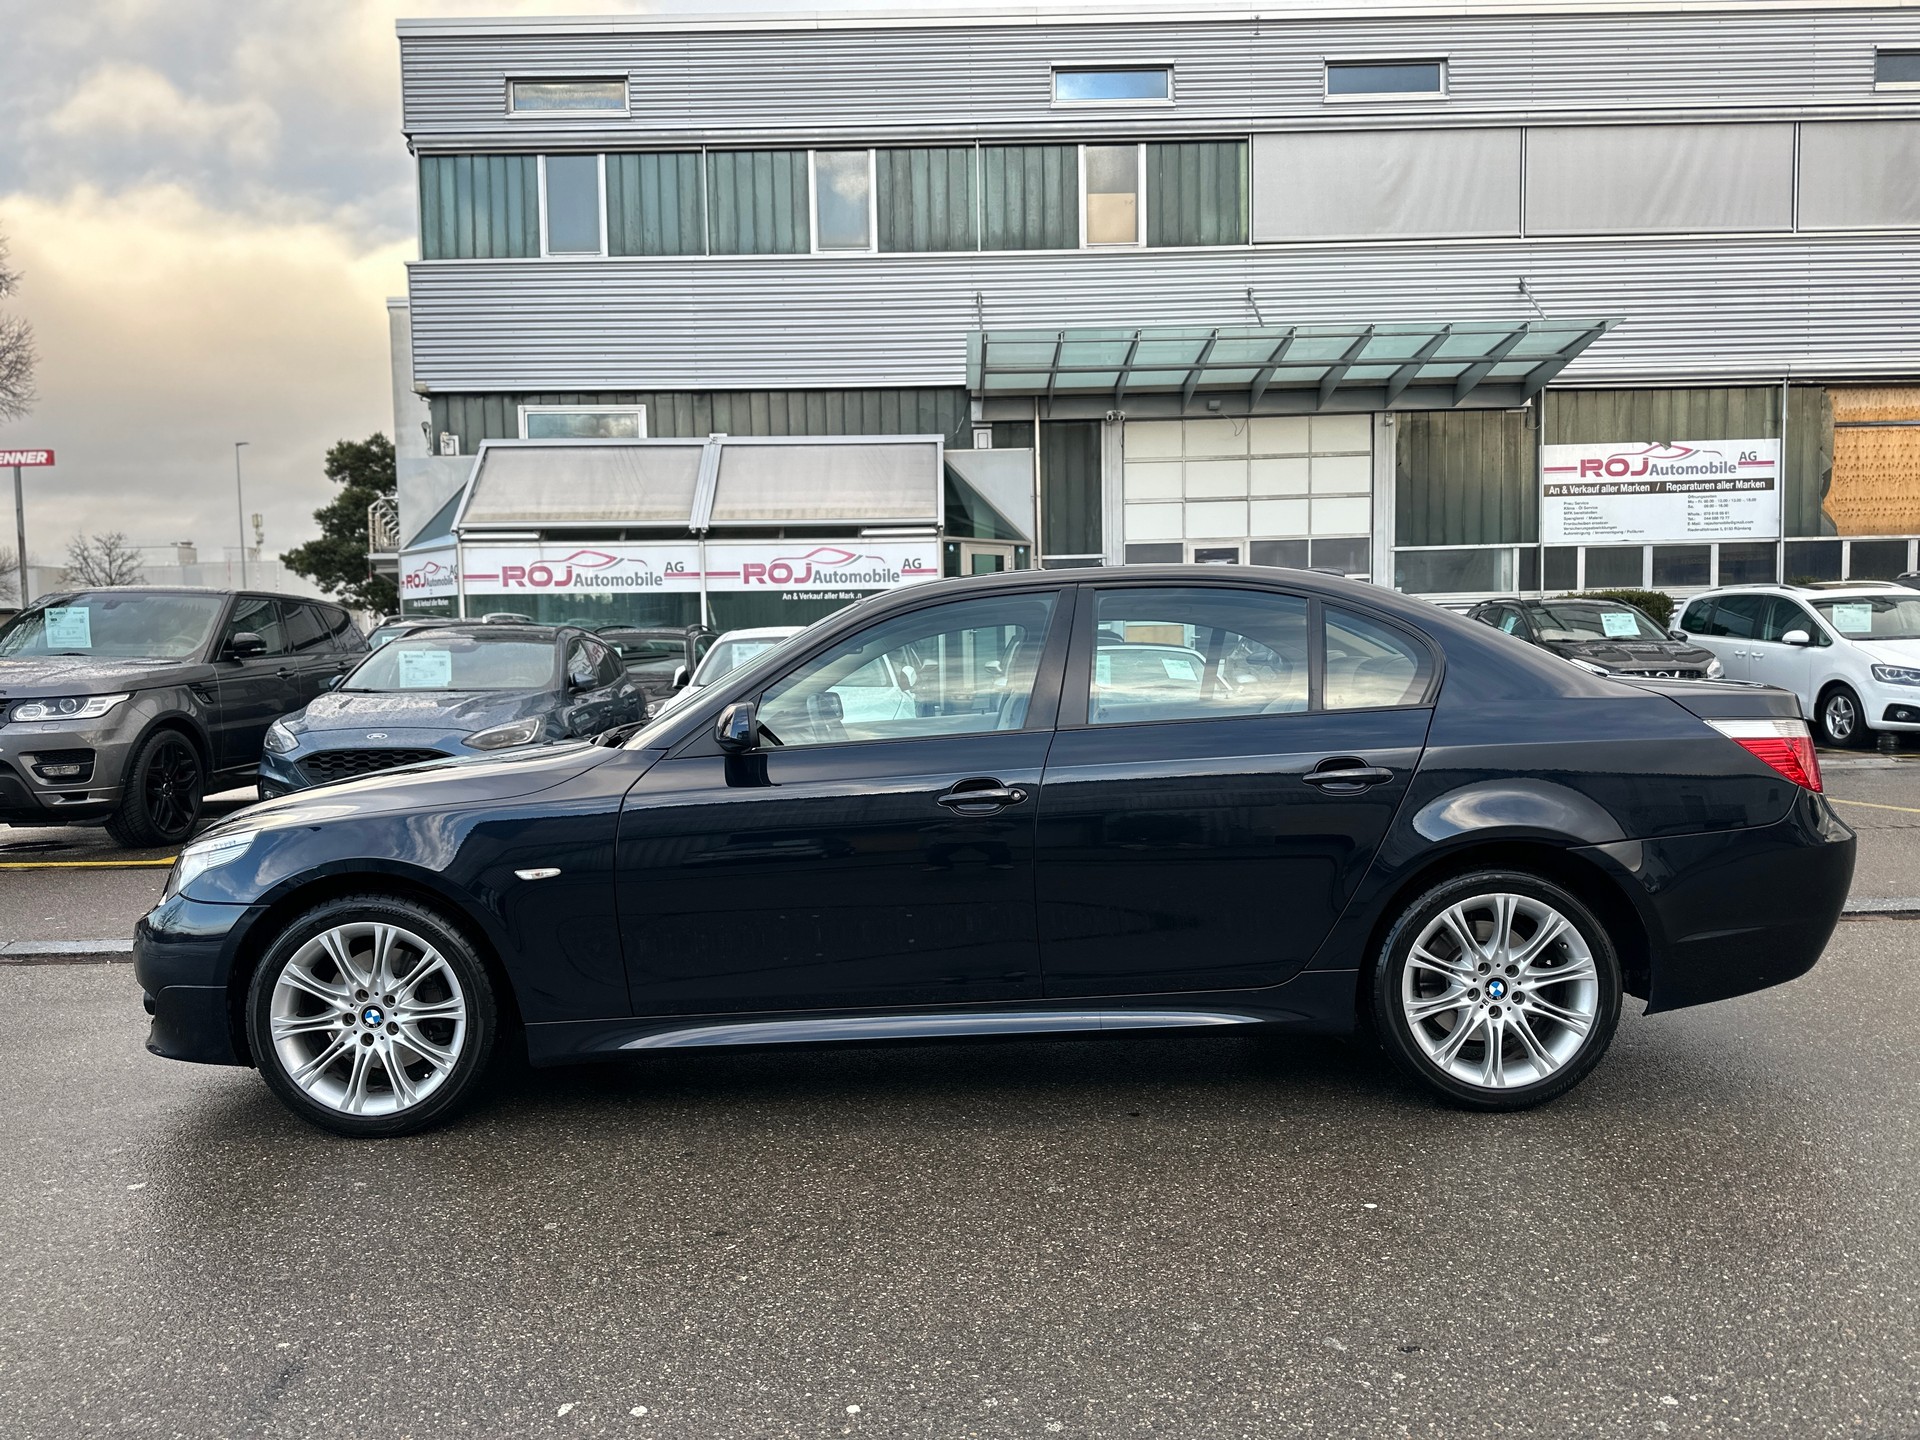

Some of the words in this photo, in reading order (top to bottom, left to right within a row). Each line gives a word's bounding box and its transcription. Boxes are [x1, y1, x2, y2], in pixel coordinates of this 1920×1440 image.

[1580, 457, 1649, 478] ROJ
[1650, 461, 1737, 476] Automobile
[1739, 451, 1757, 462] AG
[1549, 486, 1560, 494] An
[1562, 486, 1568, 494] &
[1569, 484, 1600, 494] Verkauf
[1601, 484, 1616, 493] aller
[1618, 484, 1650, 492] Marken
[1666, 482, 1714, 492] Reparaturen
[1716, 481, 1734, 490] aller
[1736, 480, 1766, 489] Marken
[406, 572, 426, 589] ROJ
[502, 565, 572, 588] ROJ
[574, 572, 663, 587] Automobile
[664, 562, 684, 572] AG
[743, 562, 812, 584] ROJ
[812, 568, 900, 584] Automobile
[902, 558, 922, 569] AG
[799, 592, 823, 600] Verkauf
